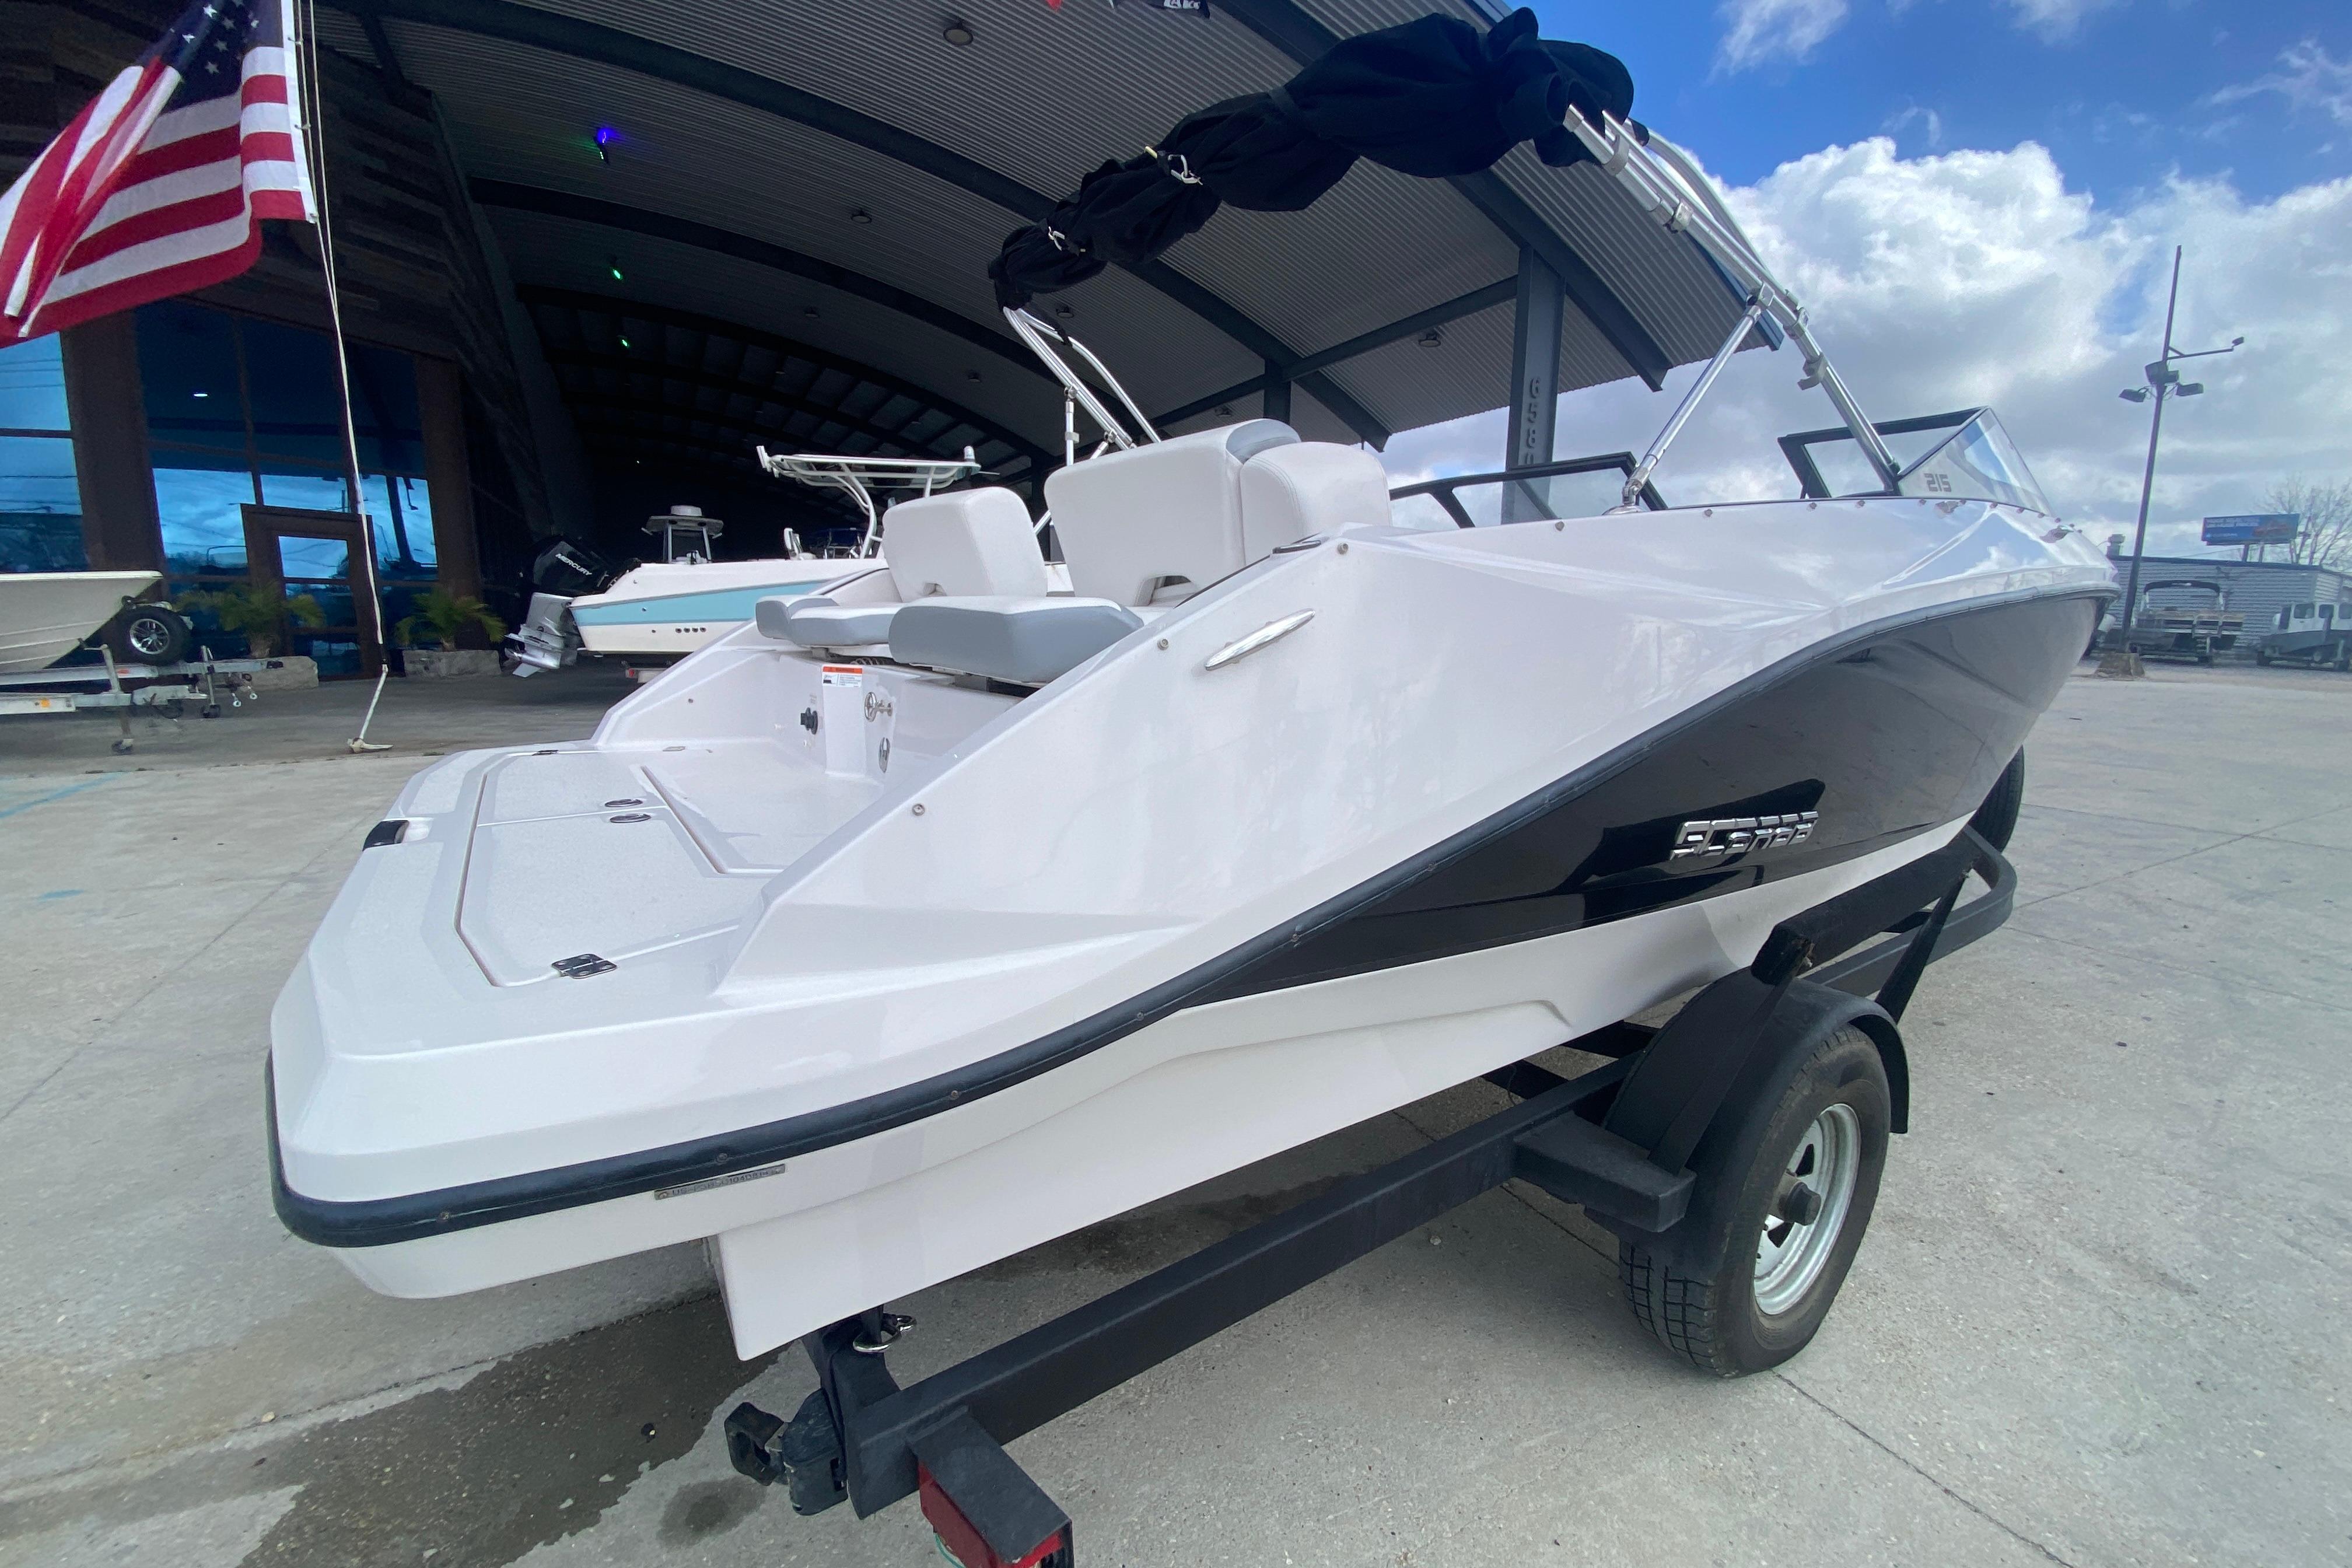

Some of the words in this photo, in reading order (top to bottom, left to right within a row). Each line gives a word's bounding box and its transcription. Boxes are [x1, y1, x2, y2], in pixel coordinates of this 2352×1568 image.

[1923, 473, 1952, 492] 215
[555, 553, 593, 576] MERCURY
[1670, 811, 1819, 860] SCARAB
